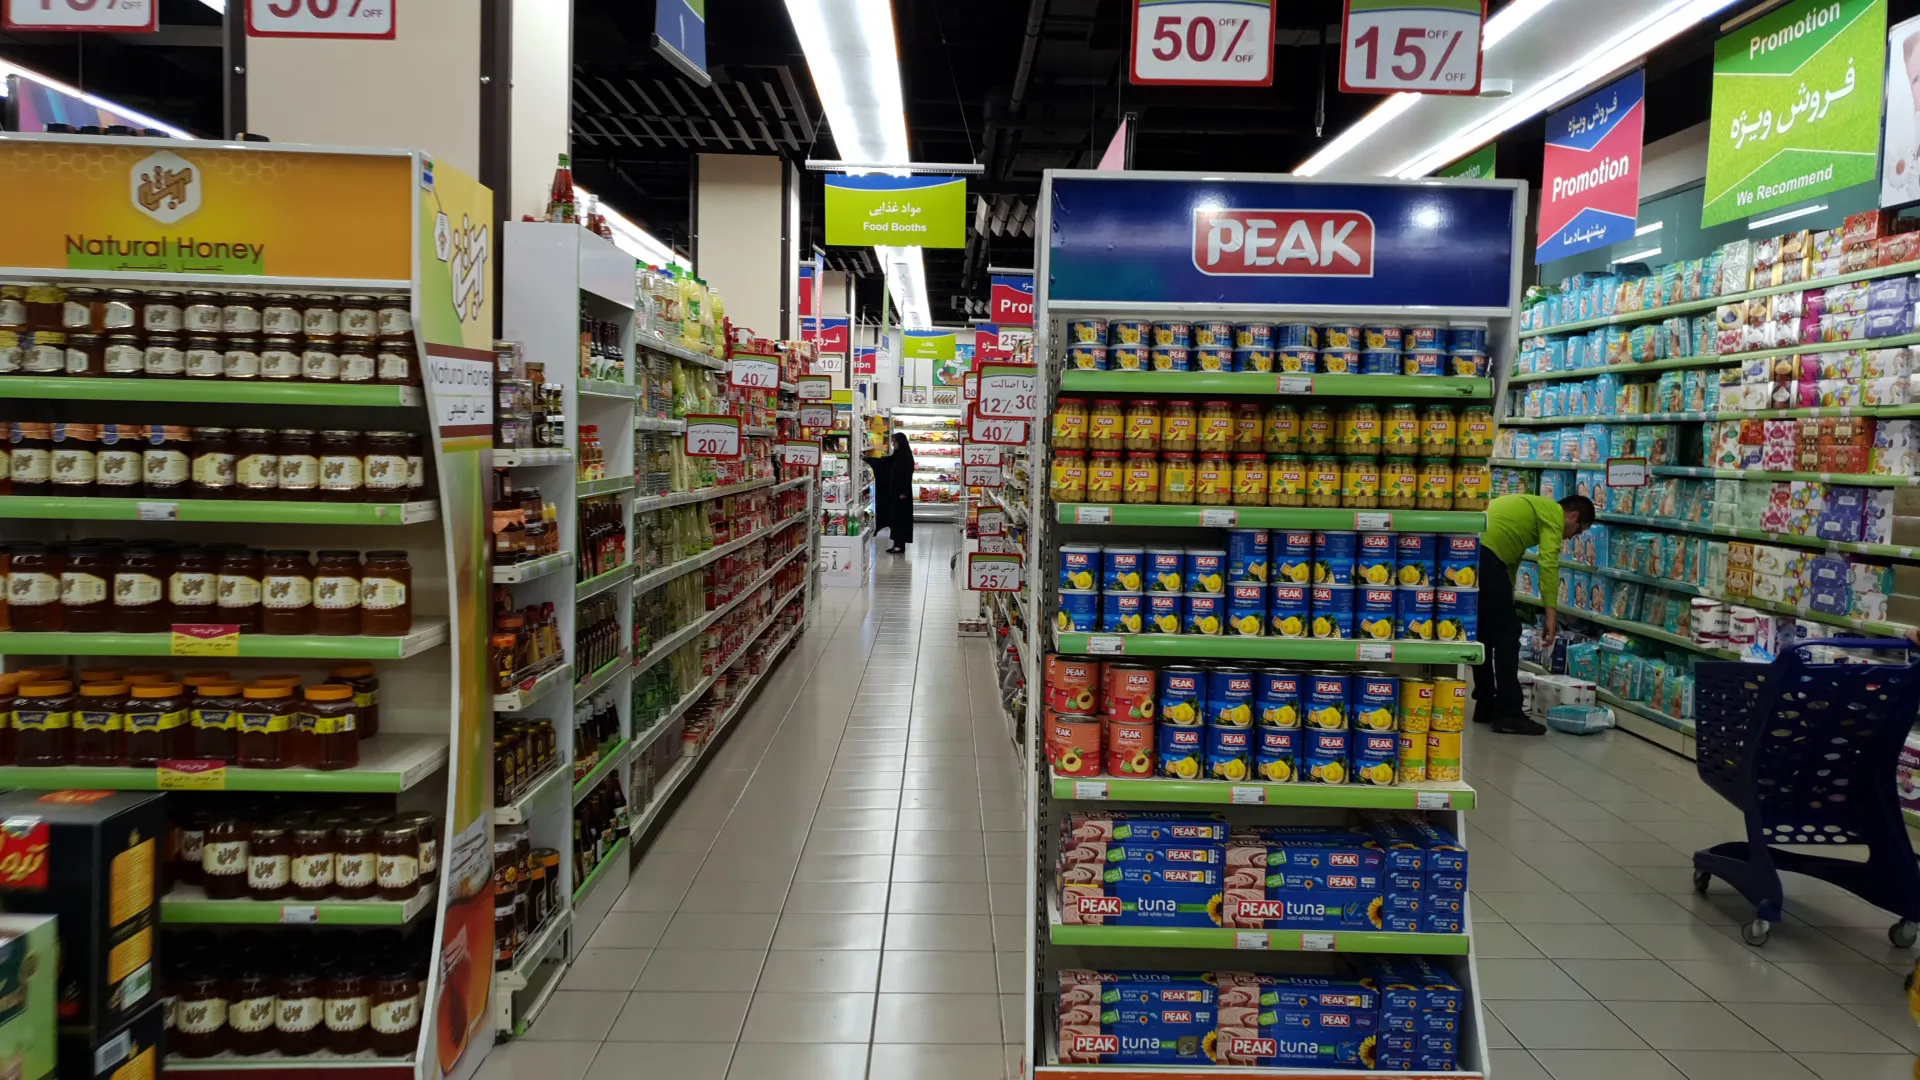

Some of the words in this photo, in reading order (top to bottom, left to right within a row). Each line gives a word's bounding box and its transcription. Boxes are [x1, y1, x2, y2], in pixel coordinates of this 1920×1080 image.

[362, 8, 384, 18] OFF
[1219, 18, 1238, 26] OFF
[1427, 30, 1449, 40] OFF
[1750, 2, 1840, 60] Promotion
[1235, 54, 1254, 63] OFF
[1444, 73, 1466, 82] OFF
[1776, 58, 1856, 134] فروش
[1587, 92, 1618, 130] فروش
[1568, 116, 1586, 138] ویژه
[1730, 110, 1772, 149] ویژه
[1552, 154, 1629, 202] Promotion
[1737, 190, 1753, 206] We
[1756, 164, 1834, 201] Recommend
[869, 202, 898, 216] غذایی
[902, 203, 922, 218] مواد
[864, 222, 888, 231] Food
[892, 223, 927, 232] Booths
[1573, 224, 1606, 243] پیشنهاد
[1208, 218, 1362, 267] PEAK
[65, 235, 168, 258] Natural
[178, 237, 264, 264] Honey
[430, 362, 465, 386] Natural
[1289, 536, 1310, 544] PEAK
[1452, 539, 1474, 548] PEAK
[1236, 589, 1258, 597] PEAK
[1279, 589, 1301, 598] PEAK
[1368, 592, 1391, 600] PEAK
[1274, 682, 1295, 690] PEAK
[1318, 683, 1339, 692] PEAK
[1175, 734, 1196, 742] PEAK
[1223, 735, 1244, 744] PEAK
[1266, 737, 1288, 745] PEAK
[1321, 738, 1342, 746] PEAK
[1332, 856, 1356, 864] PEAK
[1080, 900, 1118, 912] PEAK
[1138, 898, 1176, 911] tuna
[1240, 903, 1280, 916] PEAK
[1287, 901, 1324, 915] tuna
[1076, 1038, 1115, 1050] PEAK
[1123, 1036, 1159, 1049] tuna
[1234, 1041, 1273, 1054] PEAK
[1281, 1040, 1318, 1052] tuna
